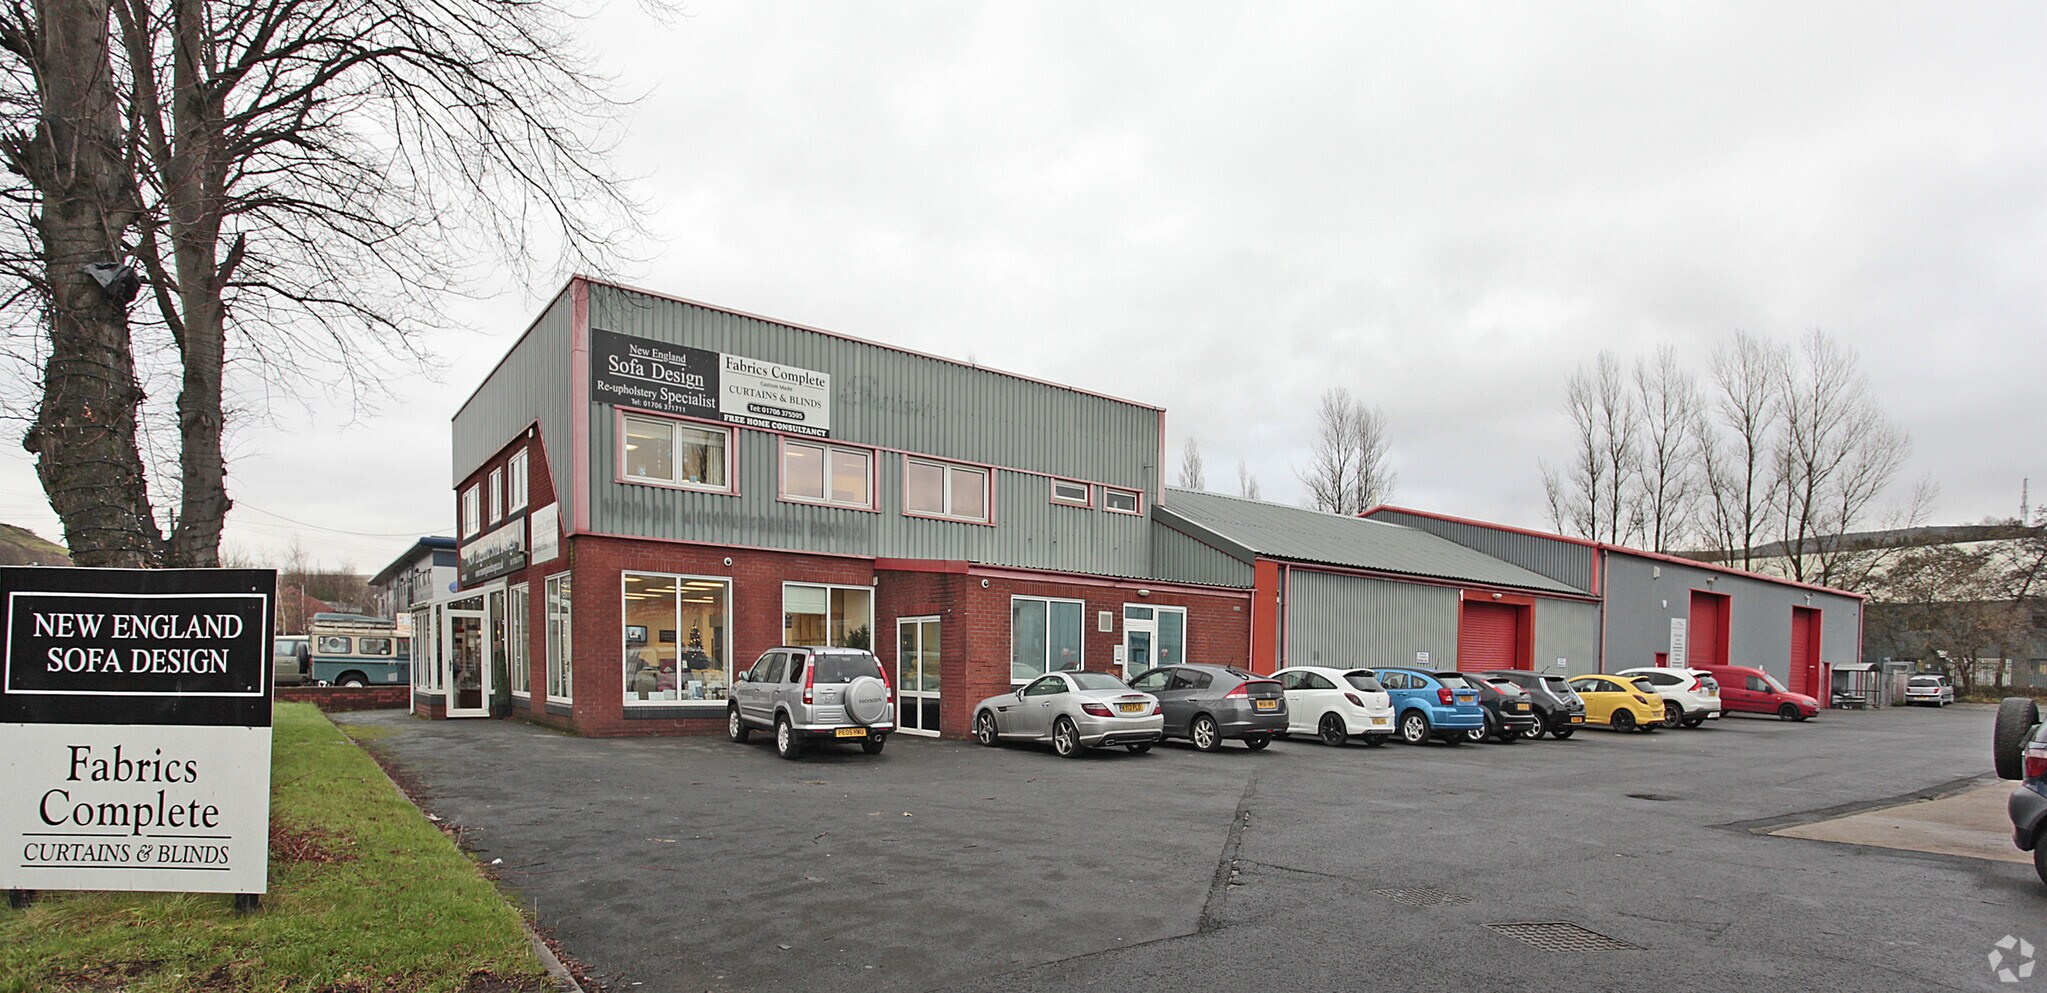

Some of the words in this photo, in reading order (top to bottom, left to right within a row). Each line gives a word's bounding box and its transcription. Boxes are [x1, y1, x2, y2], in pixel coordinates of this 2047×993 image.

[629, 344, 650, 356] New
[652, 348, 686, 363] England
[609, 355, 644, 376] Sofa
[651, 363, 704, 389] Design
[726, 356, 768, 376] Fabrics
[771, 366, 825, 387] Complete
[597, 380, 657, 400] Re-upholstery
[660, 387, 716, 409] Specialist
[729, 385, 777, 401] CURTAINS
[780, 394, 787, 403] &
[789, 395, 822, 408] BLINDS
[760, 381, 778, 389] Custom
[632, 398, 641, 406] Tel:
[643, 400, 662, 409] 01706
[762, 406, 780, 415] 01706
[723, 414, 745, 424] FREE
[747, 417, 770, 428] HOME
[771, 422, 827, 437] CONSULTANCY
[33, 613, 105, 638] NEW
[111, 613, 243, 639] ENGLAND
[47, 647, 124, 673] SOFA
[130, 648, 229, 674] DESIGN
[67, 744, 197, 783] Fabrics
[39, 789, 219, 836] Complete
[24, 842, 130, 863] CURTAINS
[136, 844, 153, 863] &
[157, 845, 229, 864] BLINDS
